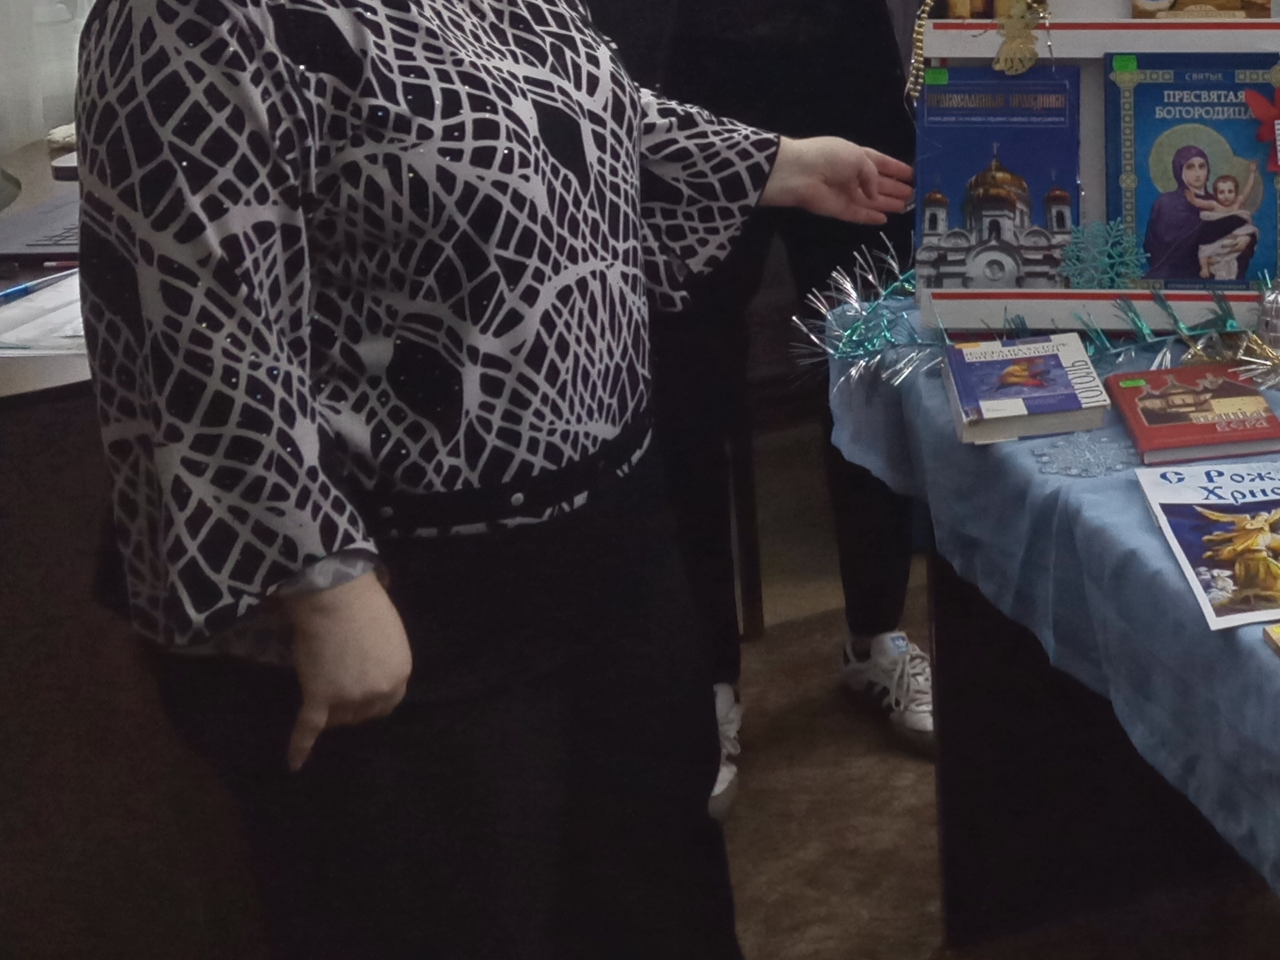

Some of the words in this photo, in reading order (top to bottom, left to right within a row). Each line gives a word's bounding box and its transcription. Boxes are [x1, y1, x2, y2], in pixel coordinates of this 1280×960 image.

[1185, 72, 1223, 81] СВЯТЫЕ
[1163, 90, 1246, 103] ПРЕСВЯТАЯ
[1155, 106, 1257, 120] БОГОРОДИЦА
